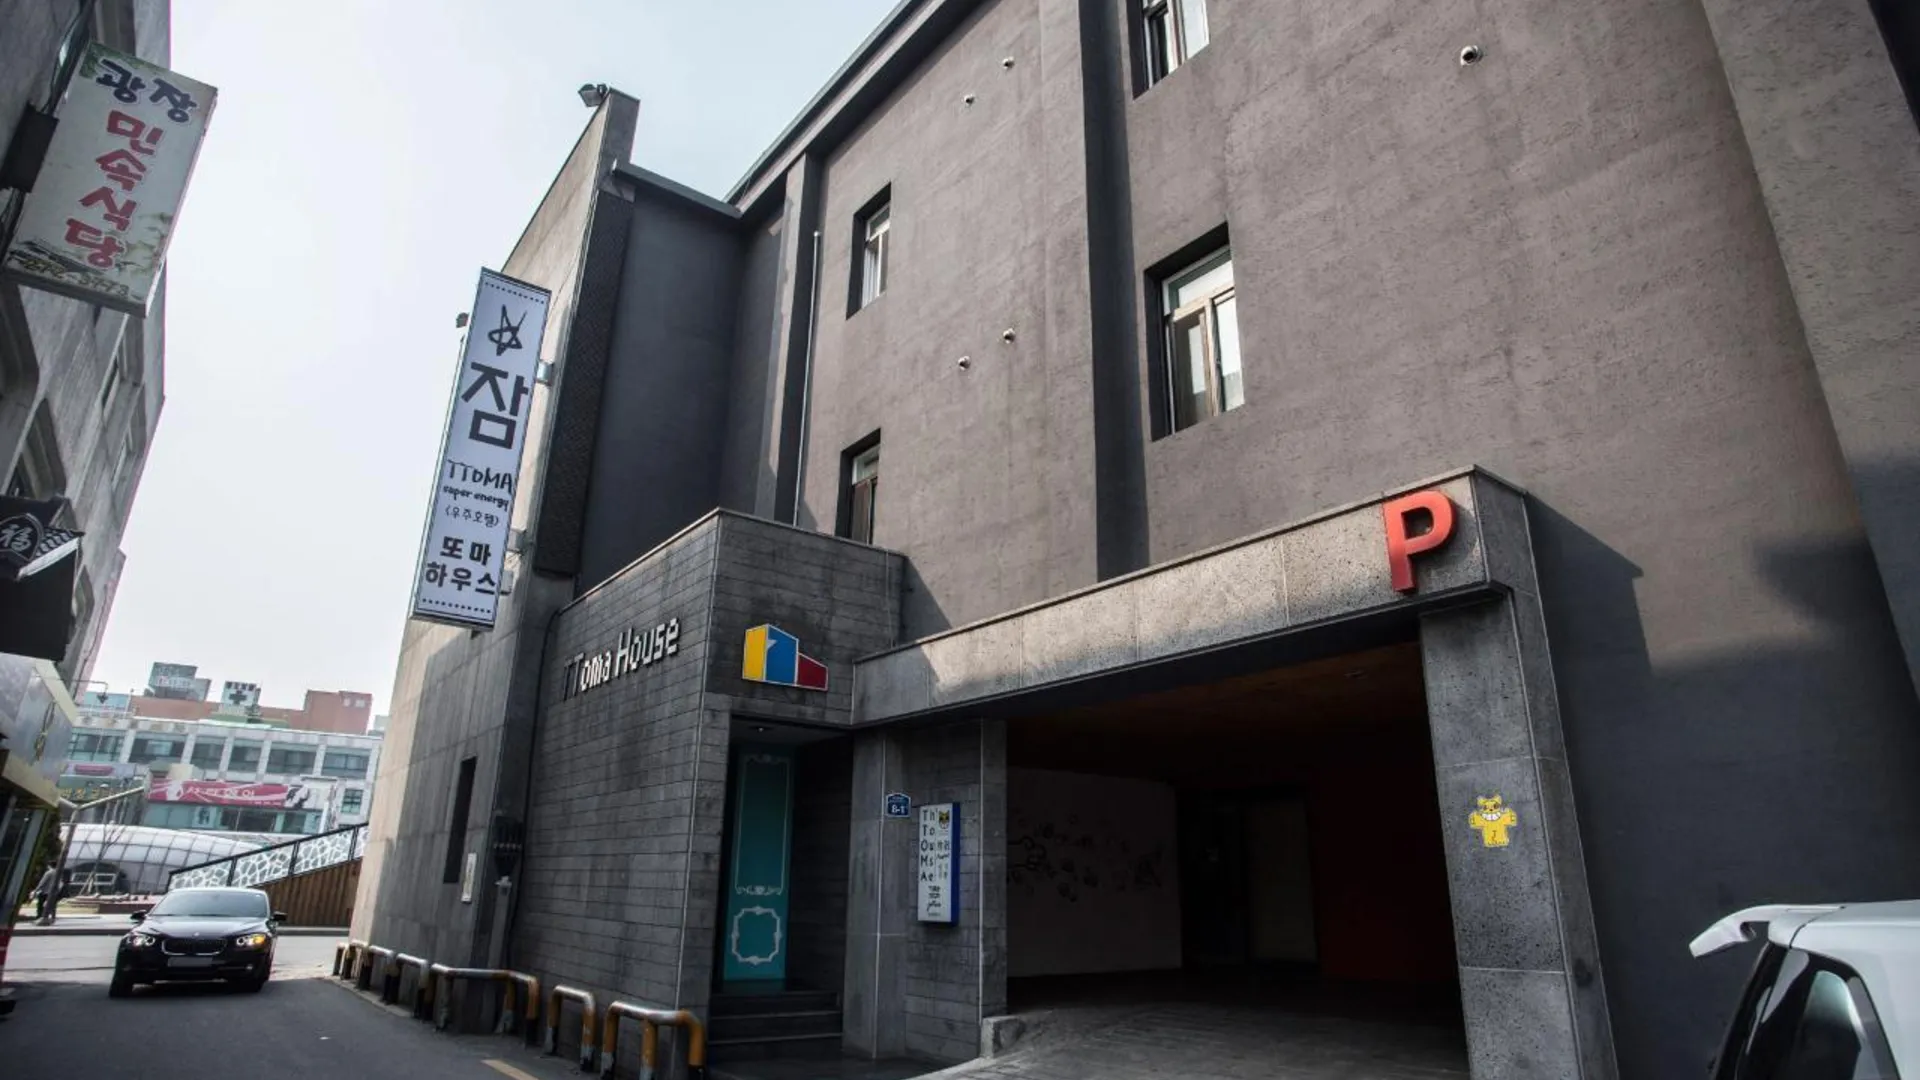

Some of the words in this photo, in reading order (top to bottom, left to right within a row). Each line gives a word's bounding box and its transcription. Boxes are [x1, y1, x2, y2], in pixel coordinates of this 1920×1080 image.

[95, 58, 197, 123] 광장
[64, 110, 164, 269] 민속식당
[461, 361, 529, 449] 잠
[473, 492, 510, 513] energy
[1382, 489, 1455, 593] P
[425, 560, 496, 595] 하우스
[614, 617, 681, 678] House
